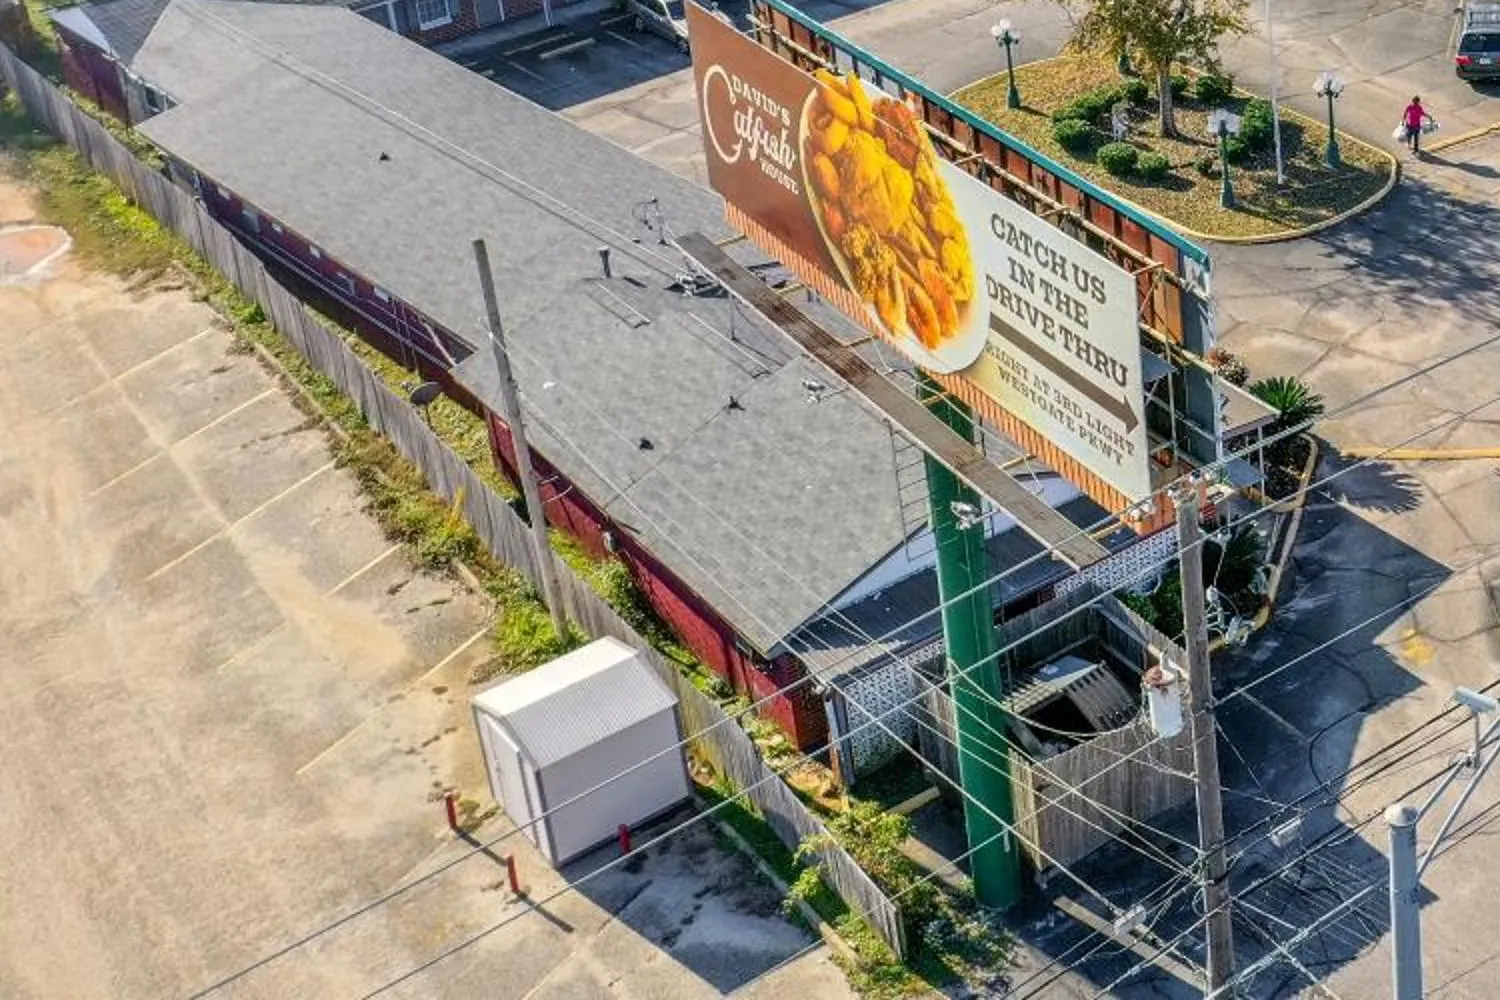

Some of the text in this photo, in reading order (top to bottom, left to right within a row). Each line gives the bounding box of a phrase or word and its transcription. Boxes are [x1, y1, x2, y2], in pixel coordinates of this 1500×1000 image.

[703, 64, 797, 170] Catfish
[731, 74, 791, 126] DAVID'S
[760, 157, 799, 195] HOUSE
[991, 213, 1107, 305] CATCH US
[1008, 256, 1089, 330] IN THE
[985, 273, 1129, 387] DRIVE THRU
[1033, 375, 1051, 396] AT
[1086, 411, 1135, 456] LIGHT
